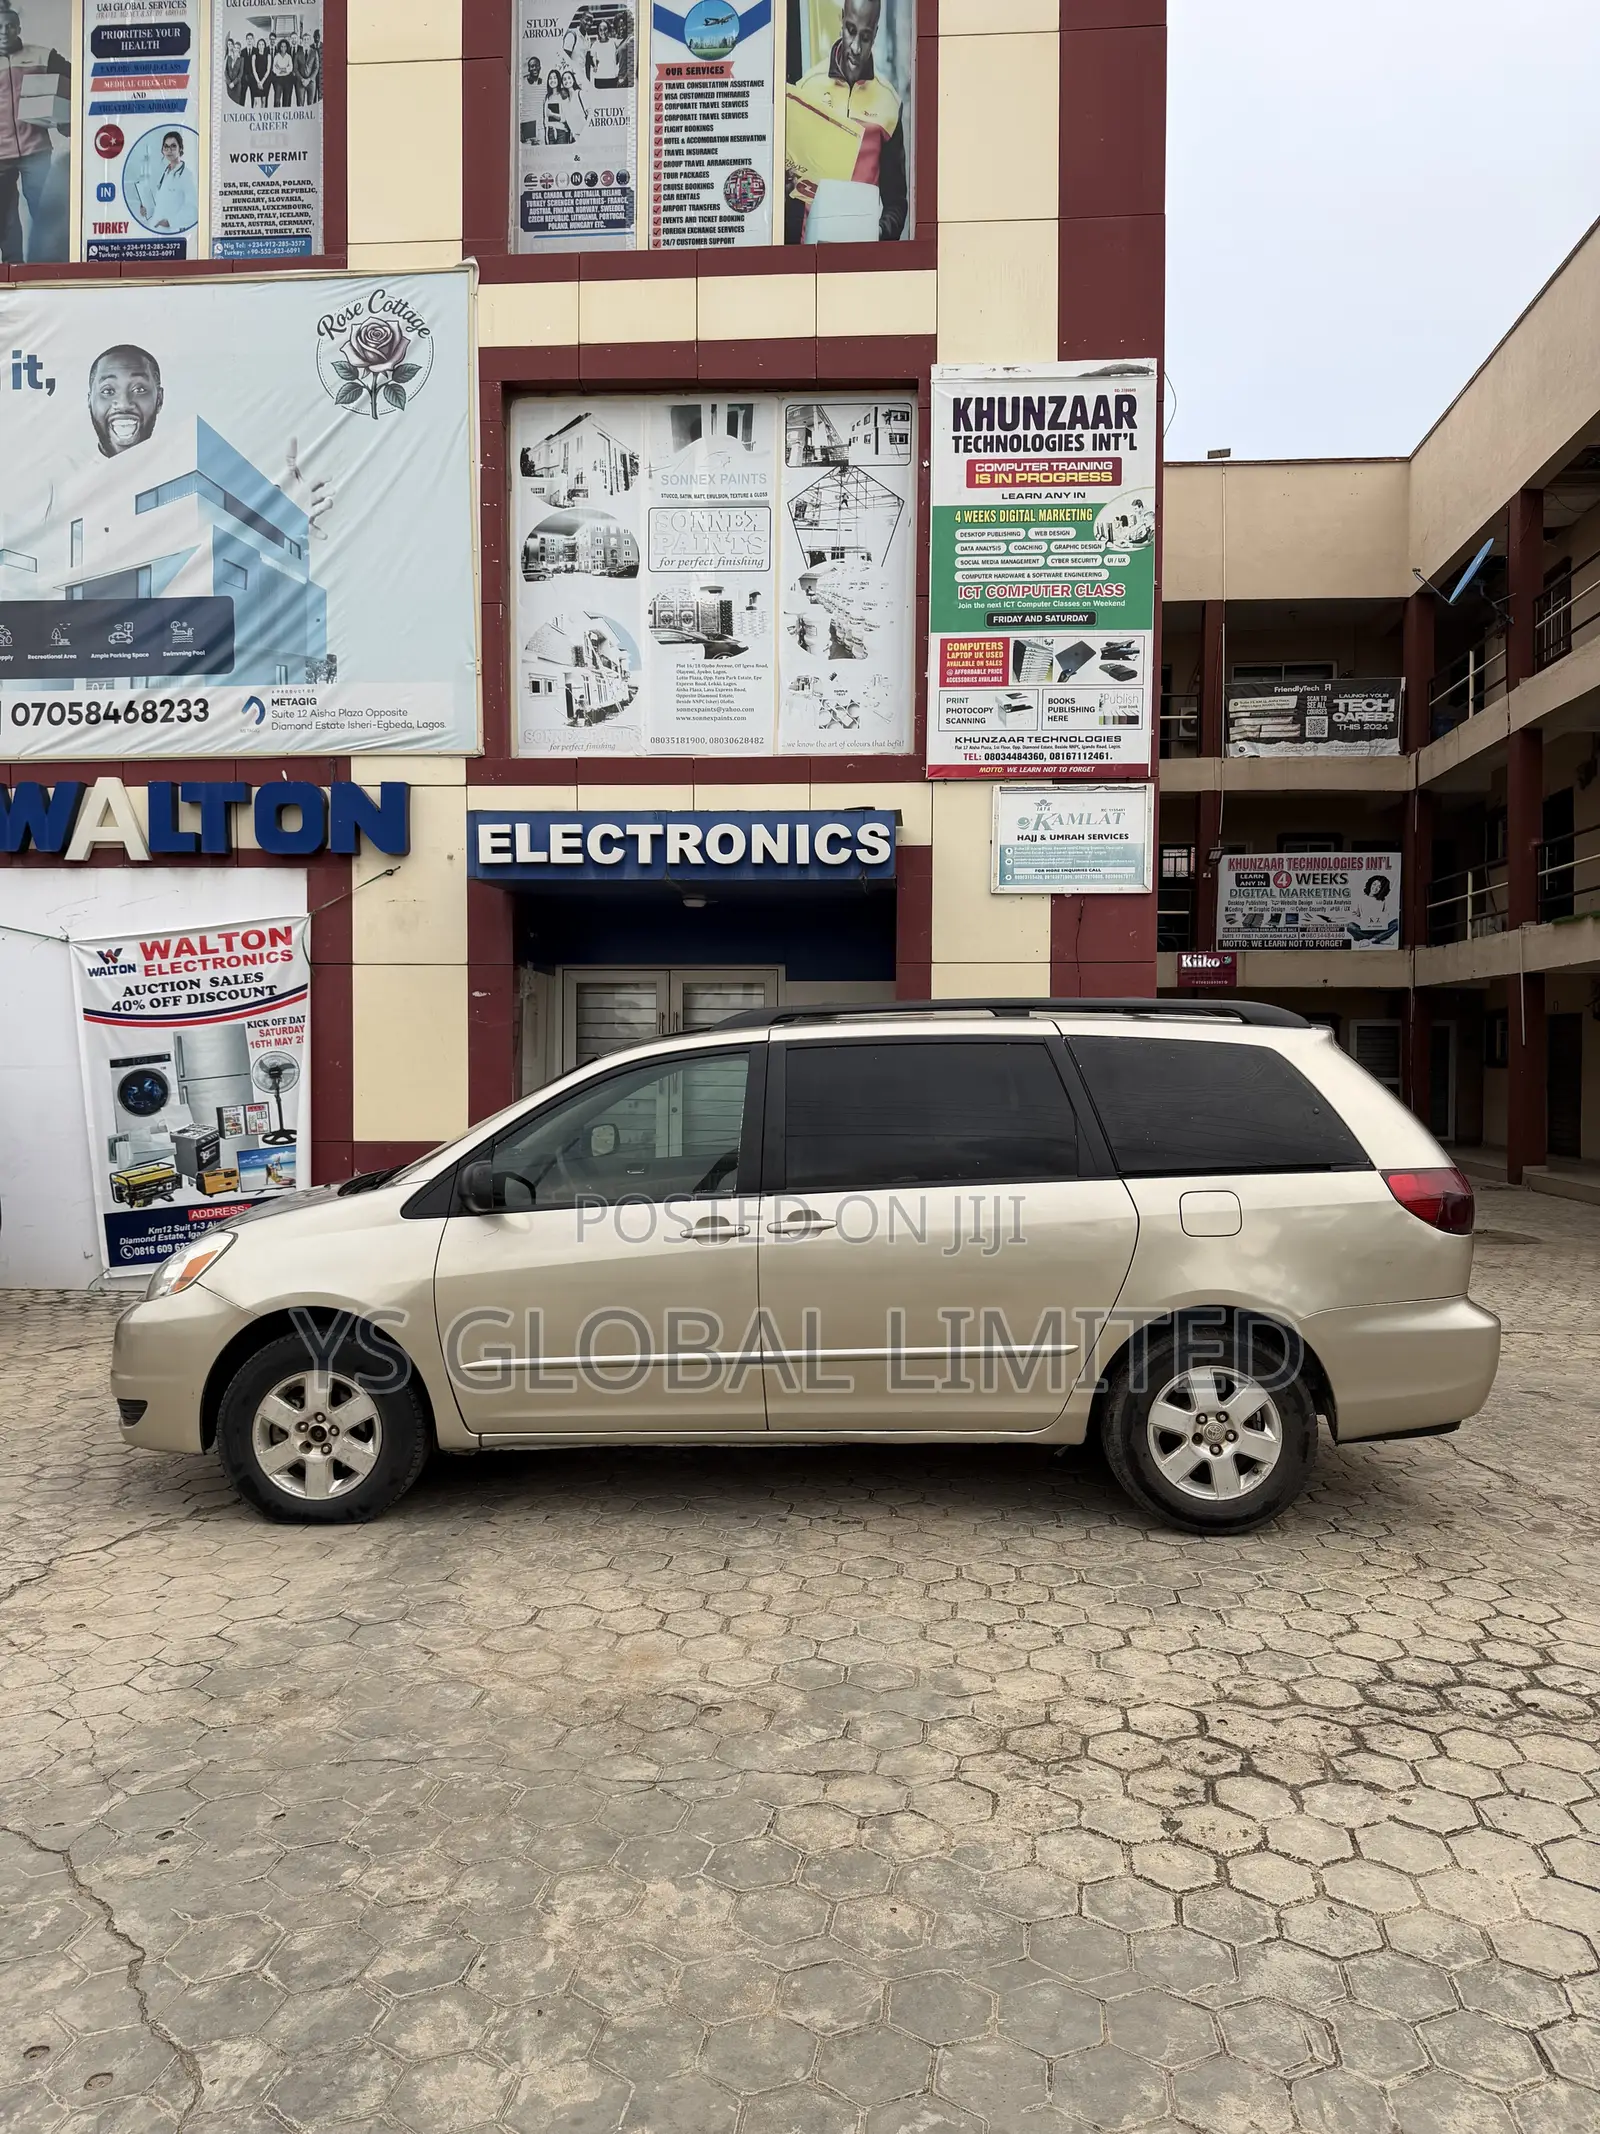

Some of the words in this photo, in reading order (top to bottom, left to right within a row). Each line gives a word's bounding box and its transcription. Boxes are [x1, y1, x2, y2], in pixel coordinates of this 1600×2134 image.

[113, 2, 147, 11] GLOBAL
[149, 0, 186, 9] SERVICES
[527, 19, 559, 28] STUDY
[101, 30, 153, 39] PRIORITISE
[155, 28, 180, 37] YOUR
[523, 28, 564, 38] ABROAD!
[121, 41, 159, 50] HEALTH
[666, 67, 683, 76] OUR
[686, 66, 724, 75] SERVICES
[687, 81, 728, 89] CONSULTATION
[730, 80, 764, 88] ASSISTANCE
[223, 113, 256, 123] UNLOCK
[258, 112, 280, 122] YOUR
[283, 111, 316, 121] GLOBAL
[594, 108, 624, 117] STUDY
[249, 121, 288, 131] CAREER
[589, 117, 630, 126] ABROAD!!
[229, 152, 264, 163] WORK
[268, 151, 308, 162] PERMIT
[100, 187, 111, 198] IN
[93, 222, 129, 234] TURKEY
[709, 237, 735, 245] SUPPORT
[316, 300, 363, 341] Rose
[367, 290, 430, 339] Cottage
[12, 350, 56, 396] it,
[952, 395, 1137, 432] KHUNZAAR
[952, 434, 1084, 453] TECHNOLOGIES
[1092, 433, 1137, 451] INT'L
[975, 462, 1048, 471] COMPUTER
[1050, 461, 1113, 470] TRAINING
[661, 474, 715, 485] SONNEX
[720, 473, 767, 484] PAINTS
[975, 474, 990, 484] IS
[995, 473, 1011, 484] IN
[1015, 472, 1113, 484] PROGRESS
[654, 511, 764, 533] SONNEX
[955, 512, 961, 523] 4
[964, 511, 996, 522] WEEKS
[1000, 509, 1035, 522] DIGITAL
[1038, 509, 1093, 521] MARKETING
[654, 533, 766, 555] PAINTS
[657, 556, 676, 569] for
[677, 556, 713, 569] perfect
[714, 556, 764, 568] finishing
[959, 586, 981, 599] ICT
[986, 585, 1071, 598] COMPUTER
[1075, 584, 1125, 597] CLASS
[993, 615, 1023, 623] FRIDAY
[1045, 614, 1088, 622] SATURDAY
[947, 642, 1003, 651] COMPUTERS
[162, 650, 191, 658] Swimming
[192, 649, 206, 657] Pool
[271, 697, 317, 707] METAGIG
[1307, 701, 1316, 709] SEE
[1333, 699, 1394, 712] TECH
[11, 697, 209, 726] 07058468233
[271, 710, 295, 718] Suite
[298, 710, 307, 718] 12
[310, 709, 335, 718] Aisha
[338, 708, 363, 717] Plaza
[366, 708, 408, 718] Opposite
[676, 705, 755, 713] sonnexpaints@yahoo.com
[271, 722, 311, 730] Diamond
[315, 722, 345, 730] Estate
[348, 720, 415, 732] Isheri-Egbeda,
[417, 720, 446, 731] Lagos.
[650, 736, 707, 745] 08035181900,
[709, 736, 764, 745] 08030628482
[1027, 735, 1121, 743] TECHNOLOGIES
[984, 752, 1047, 761] 08034484360,
[1049, 752, 1113, 760] 08167112461.
[0, 776, 411, 864] WALTON
[1032, 813, 1125, 830] KAMLAT
[477, 822, 894, 866] ELECTRONICS
[1017, 834, 1037, 842] HAJJ
[1228, 858, 1284, 871] KHUNZAAR
[1286, 857, 1363, 871] TECHNOLOGIES
[1366, 857, 1392, 870] INT'L
[1276, 873, 1288, 886] 4
[1296, 873, 1348, 885] WEEKS
[1230, 888, 1276, 898] DIGITAL
[1279, 888, 1350, 897] MARKETING
[140, 926, 293, 962] WALTON
[143, 949, 294, 977] ELECTRONICS
[88, 963, 137, 977] WALTON
[123, 978, 201, 998] AUCTION
[210, 972, 265, 987] SALES
[112, 999, 146, 1013] 40%
[149, 996, 182, 1009] OFF
[186, 985, 277, 1006] DISCOUNT
[247, 1019, 270, 1029] KICK
[271, 1017, 287, 1026] OFF
[259, 1025, 305, 1037] SATURDAY
[250, 1038, 272, 1049] 16TH
[274, 1037, 293, 1047] MAY
